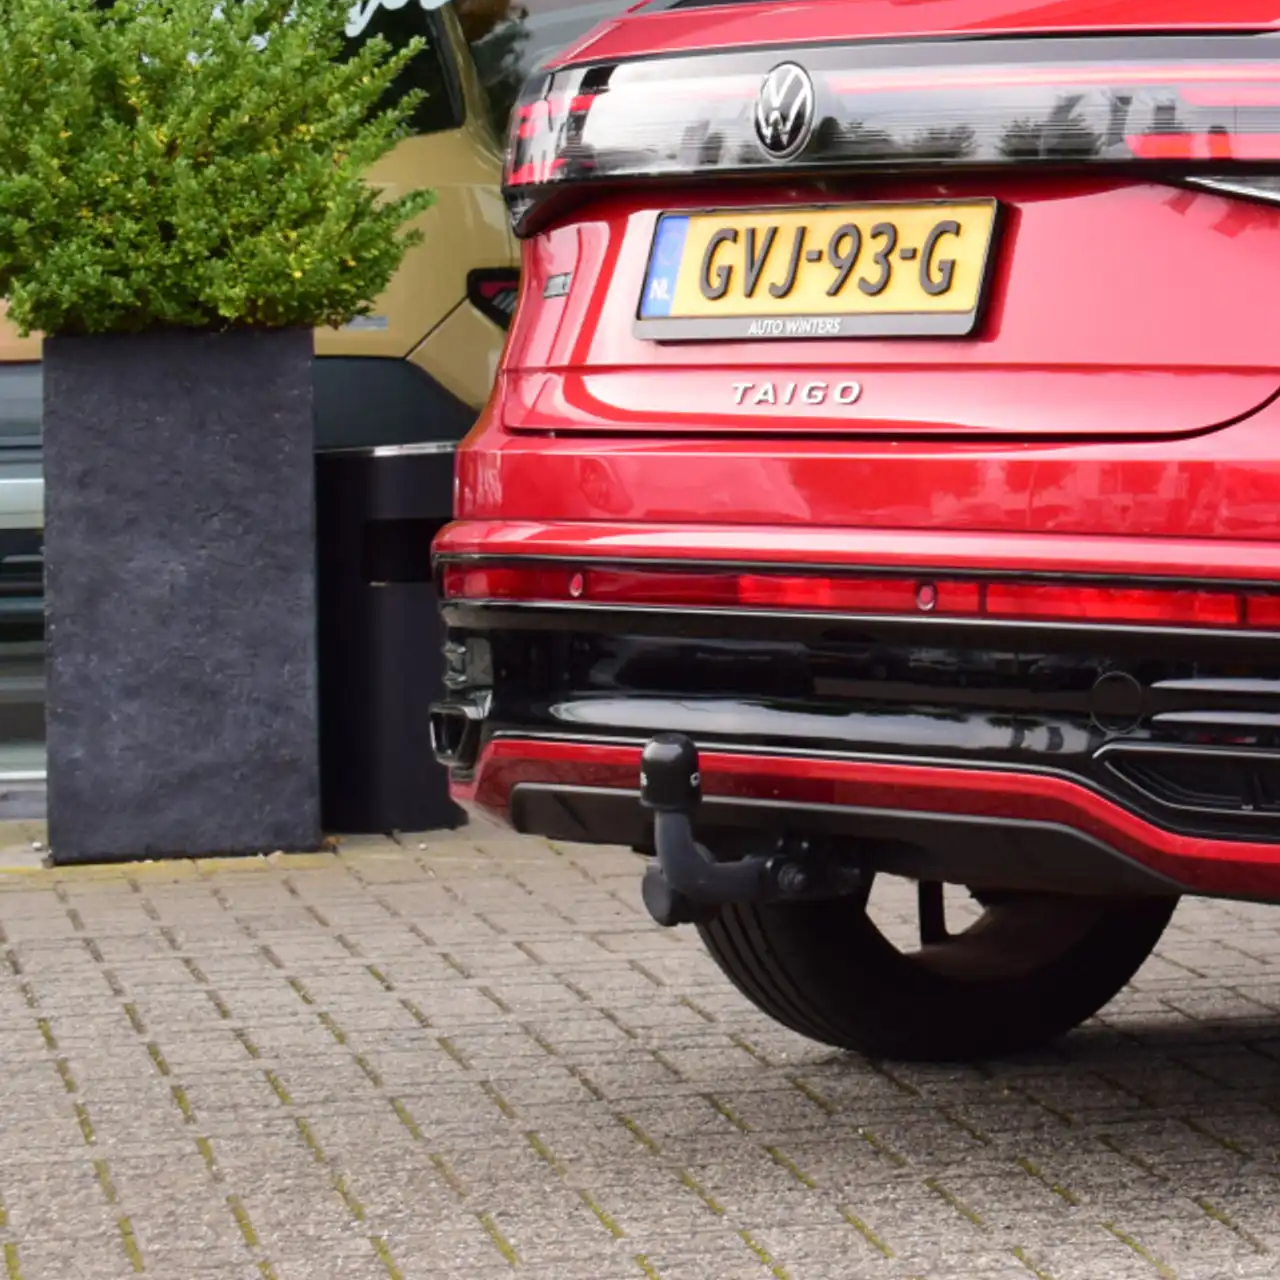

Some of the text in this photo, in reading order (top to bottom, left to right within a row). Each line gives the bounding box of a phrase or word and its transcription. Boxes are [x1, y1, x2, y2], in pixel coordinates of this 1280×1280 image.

[700, 220, 961, 301] GVJ-93-G
[650, 278, 671, 300] NL
[748, 317, 842, 336] AUTO WINTERS
[732, 381, 863, 405] TAIGO
